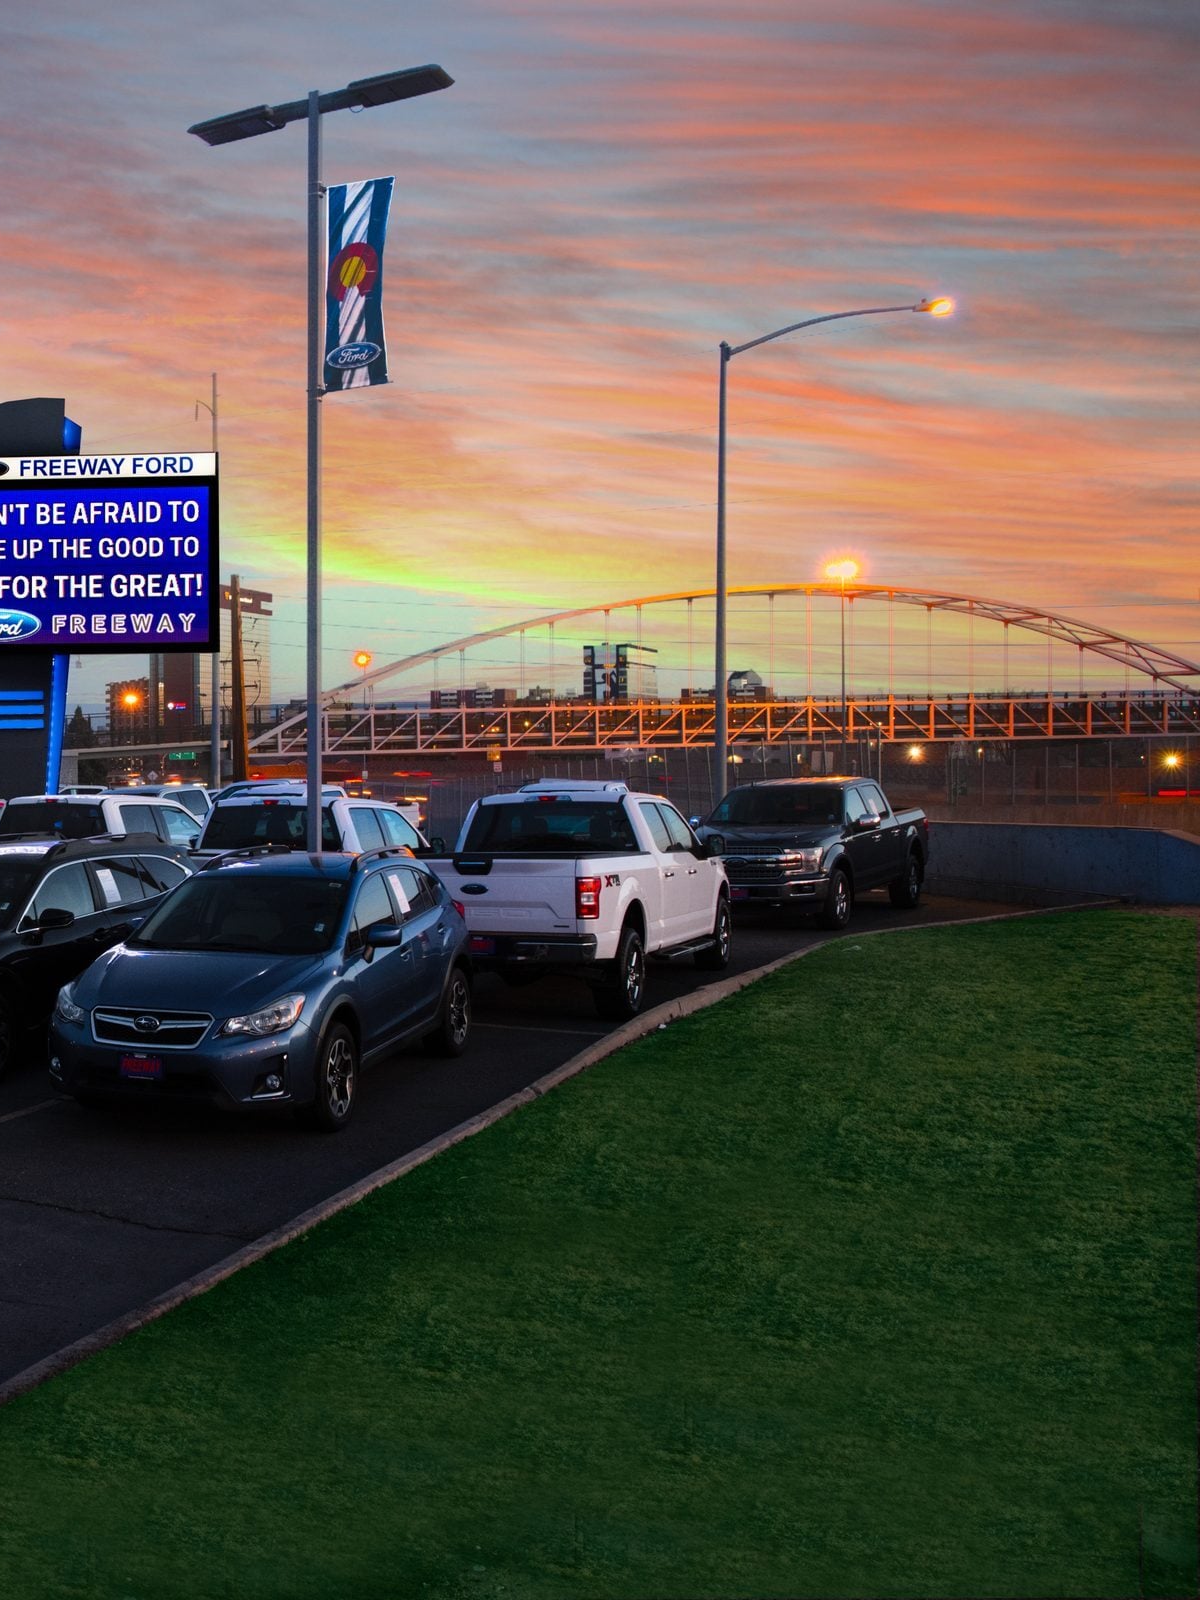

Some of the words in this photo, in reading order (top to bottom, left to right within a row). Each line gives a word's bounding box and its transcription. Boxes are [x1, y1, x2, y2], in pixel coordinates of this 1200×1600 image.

[338, 348, 374, 364] Ford
[19, 457, 126, 477] FREEWAY
[132, 456, 194, 475] FORD
[35, 502, 66, 525] BE
[72, 500, 163, 525] AFRAID
[167, 500, 200, 523] TO
[12, 538, 43, 559] UP
[48, 538, 93, 559] THE
[98, 537, 164, 558] GOOD
[170, 536, 200, 557] TO
[53, 574, 105, 598] THE
[109, 573, 203, 598] GREAT!
[51, 612, 196, 635] FREEWAY
